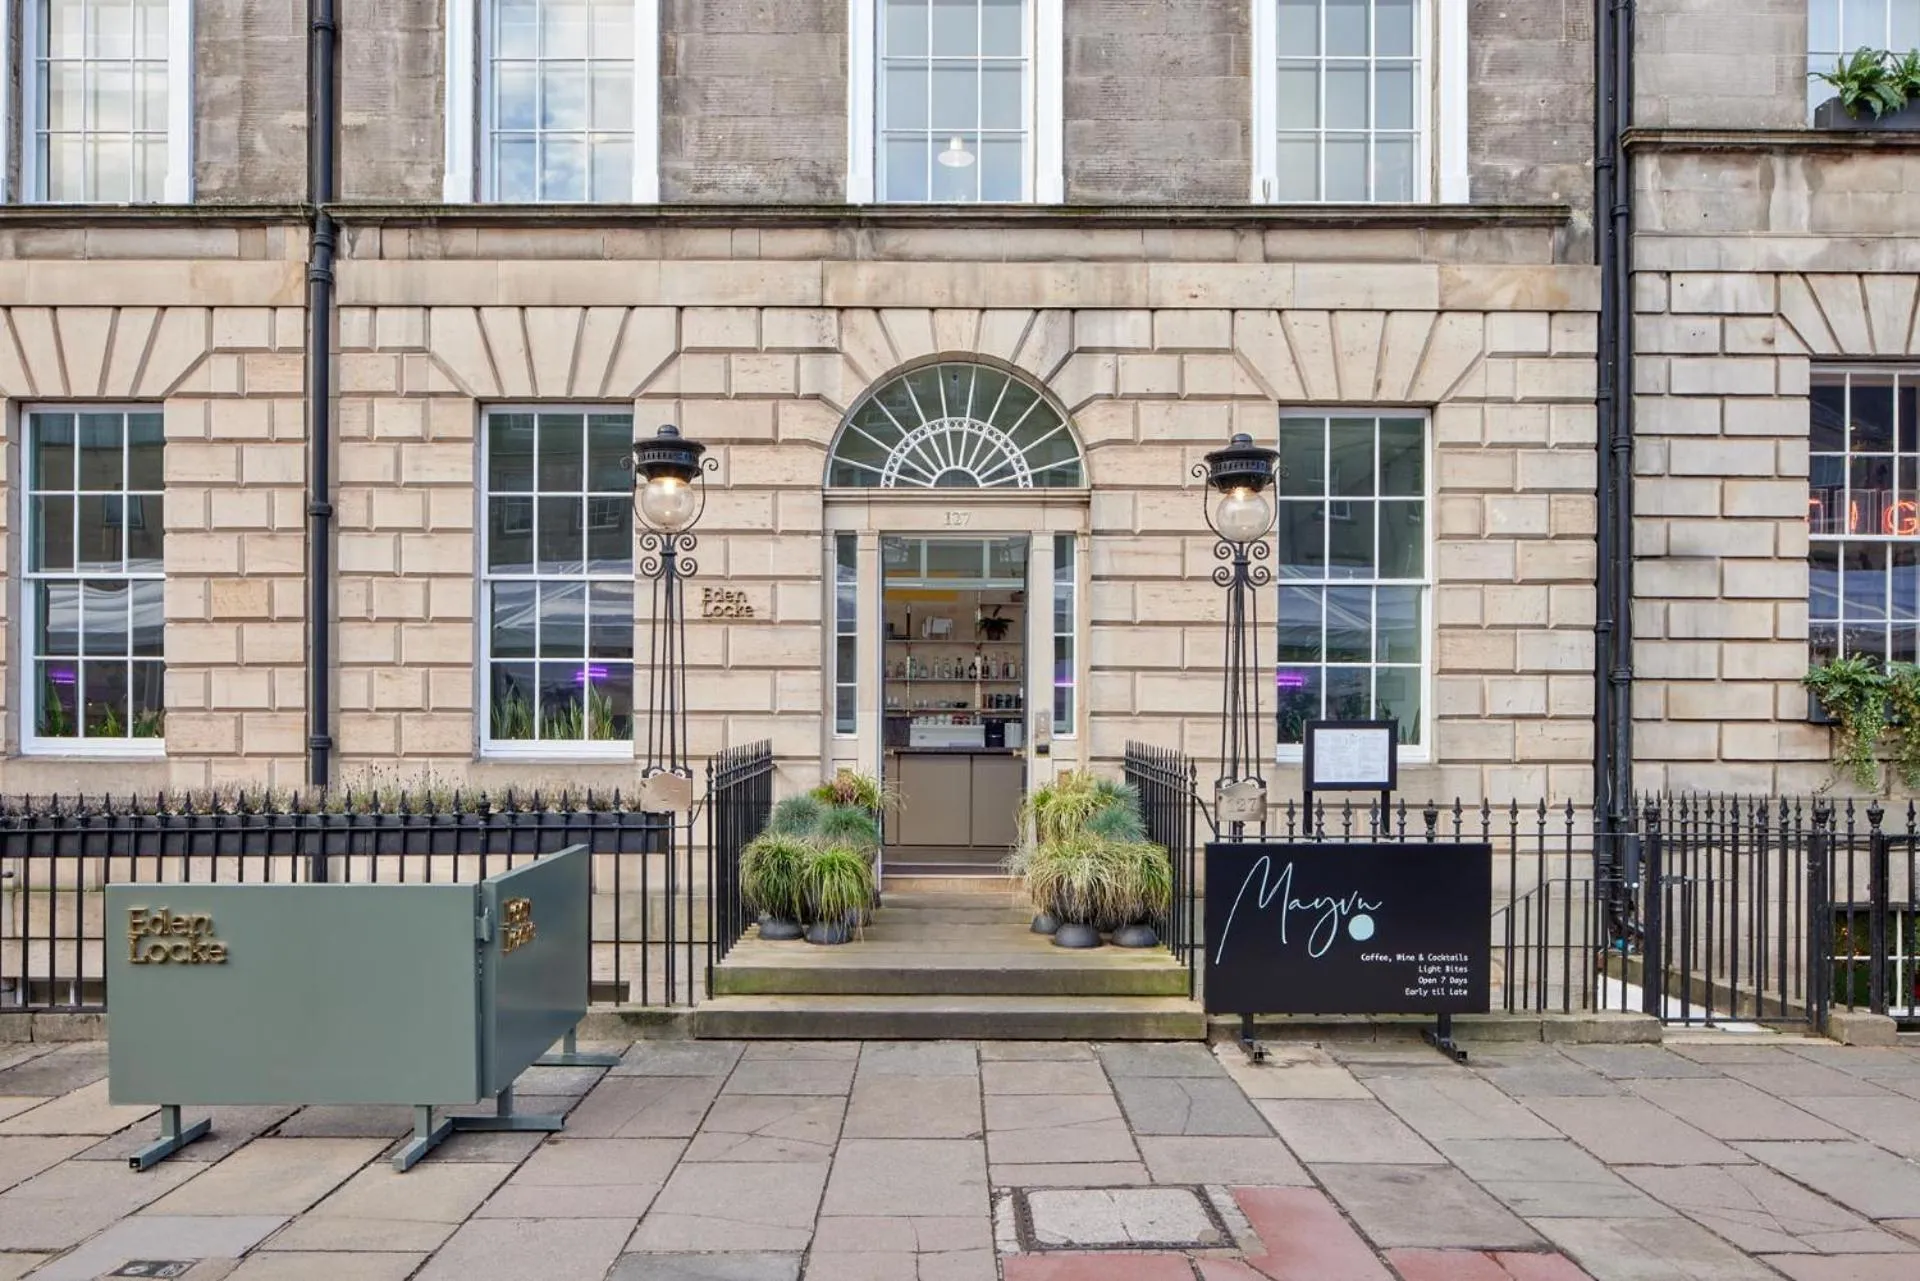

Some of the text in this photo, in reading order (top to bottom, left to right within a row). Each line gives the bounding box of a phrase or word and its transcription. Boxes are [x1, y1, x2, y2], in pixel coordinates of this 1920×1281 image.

[944, 511, 972, 527] 127
[702, 587, 747, 602] Eden
[702, 600, 754, 618] Locke
[127, 905, 214, 936] Eden
[127, 935, 229, 964] Locke
[1361, 953, 1469, 963] Coffee, Wine & Cocktails
[1418, 964, 1469, 974] Light Bites
[1418, 976, 1468, 986] Open 7 Days
[1404, 987, 1428, 997] Early
